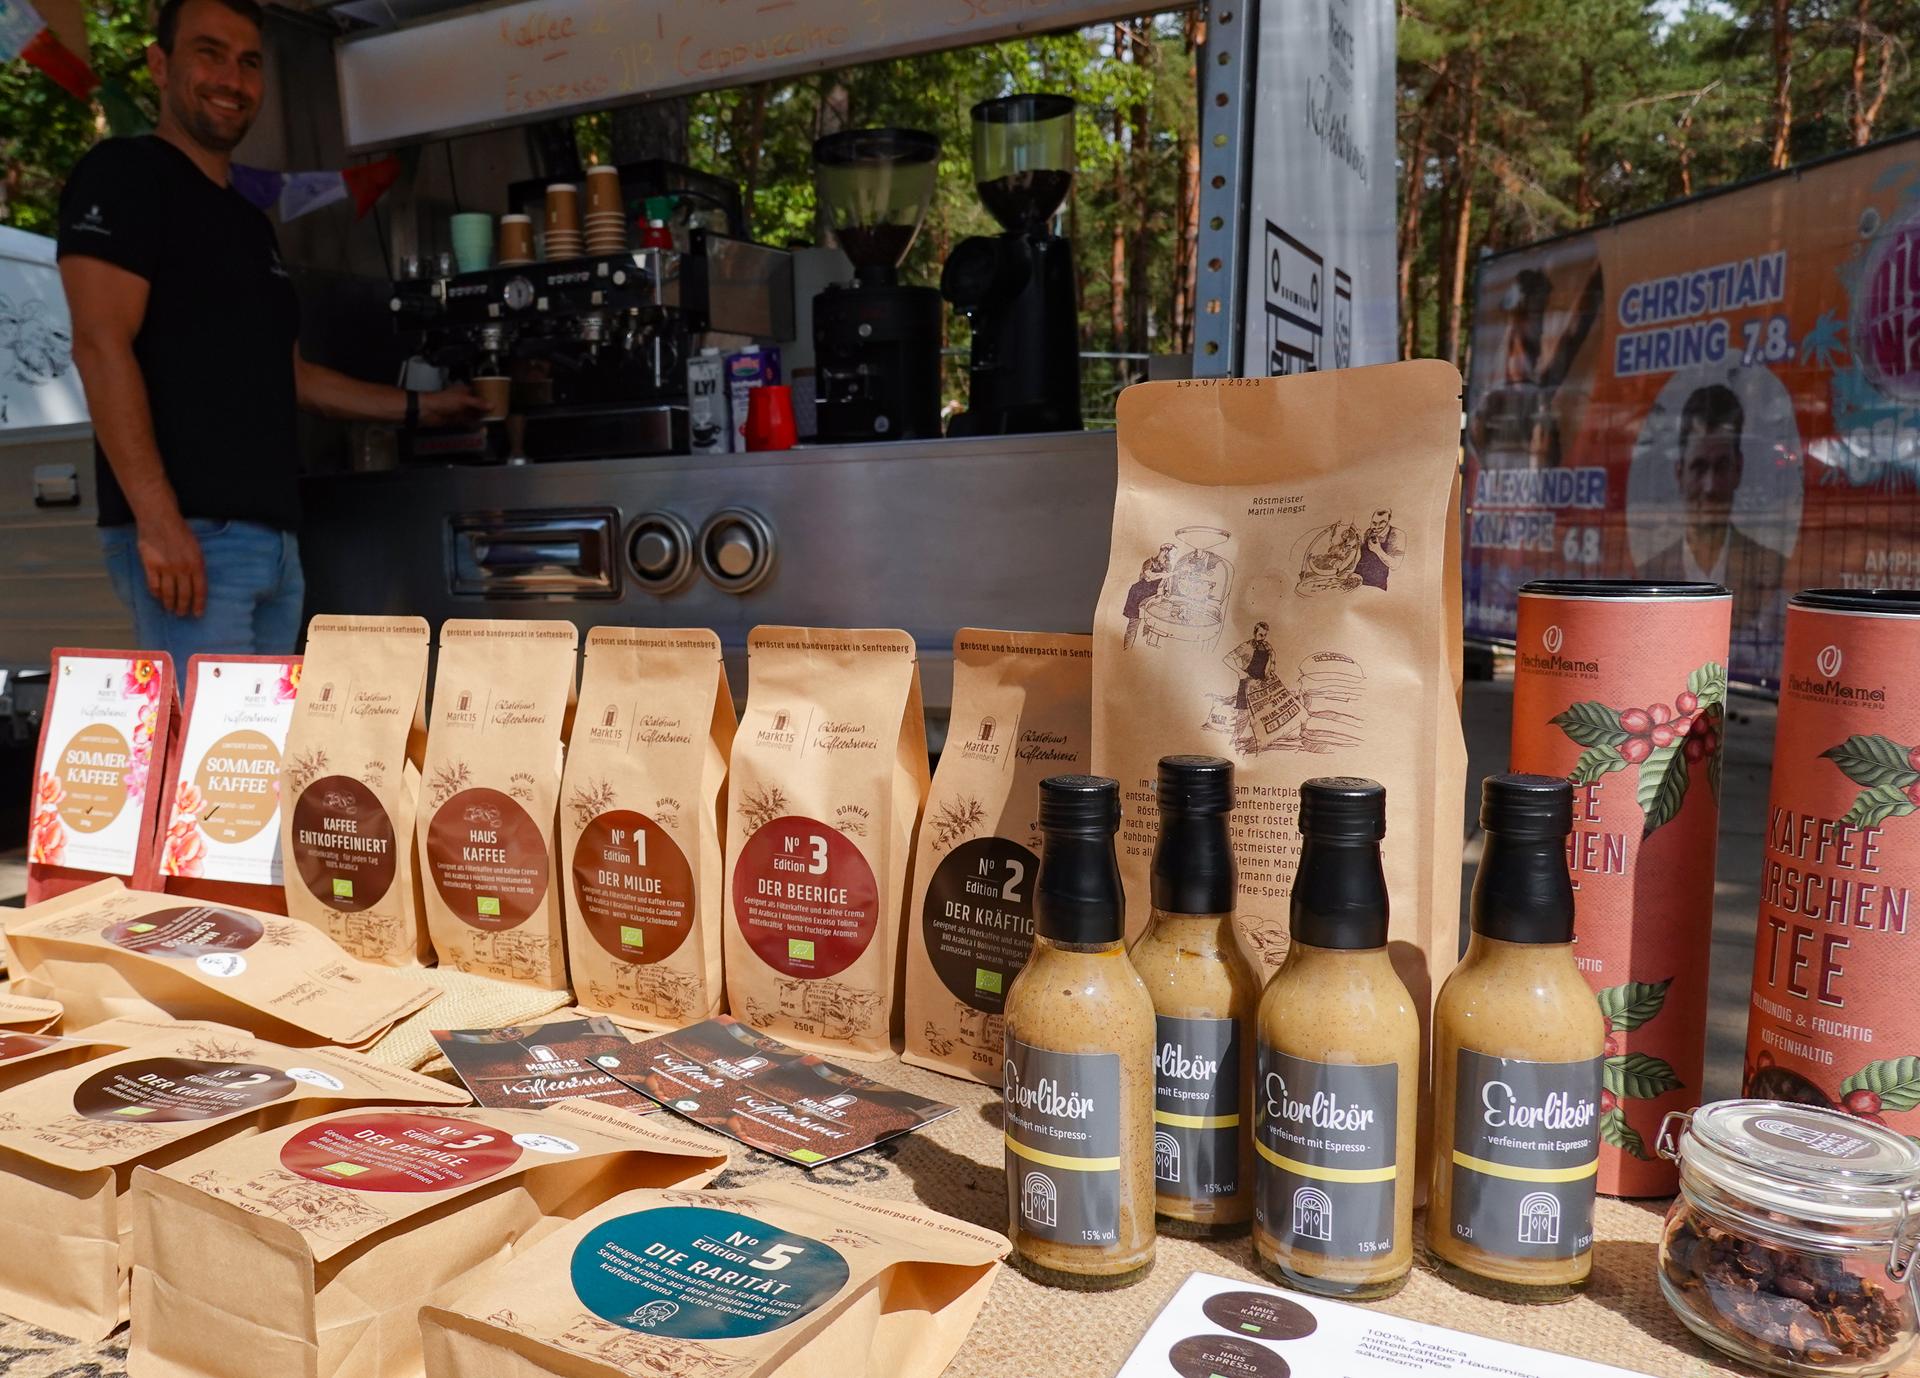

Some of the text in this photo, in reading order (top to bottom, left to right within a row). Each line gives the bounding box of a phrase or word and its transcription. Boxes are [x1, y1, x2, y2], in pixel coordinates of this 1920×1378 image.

[1621, 254, 1784, 325] CHRISTIAN
[1616, 317, 1794, 374] EHRING 7.8.
[1177, 379, 1261, 388] 19.07.2023
[1475, 468, 1605, 507] ALEXANDER
[1253, 495, 1304, 505] Röstmeister
[1248, 504, 1306, 517] Martin Hengst
[1471, 512, 1554, 547] KNAPPE
[393, 627, 425, 635] Senftenberg
[447, 629, 472, 637] geröstet
[486, 630, 527, 638] handverpackt
[536, 631, 573, 640] Senftenberg
[755, 640, 909, 654] geröstet und handverpackt in Senftenberg
[960, 642, 989, 651] geröstet
[992, 643, 1004, 652] und
[1007, 646, 1057, 656] handverpackt
[309, 703, 327, 712] Markt
[446, 712, 477, 722] Markt 15
[590, 727, 612, 738] Markt
[757, 730, 795, 743] Markt 15
[963, 741, 999, 754] Markt 15
[66, 749, 126, 768] SOMMER
[206, 757, 275, 775] SOMMER
[67, 768, 119, 786] KAFFEE
[207, 776, 268, 794] KAFFEE
[510, 772, 536, 785] BOHNEN
[1140, 779, 1149, 788] Im
[1235, 786, 1300, 798] am Marktplat
[656, 797, 680, 810] BOHNEN
[836, 804, 869, 818] BOHNEN
[324, 818, 357, 833] KAFFEE
[1126, 818, 1144, 829] nach
[300, 830, 387, 853] ENTKOFFEINIERT
[470, 830, 497, 844] HAUS
[1247, 828, 1291, 840] frischen,
[1770, 806, 1884, 873] KAFFEE
[463, 847, 506, 863] KAFFEE
[603, 849, 631, 864] Edition
[633, 829, 646, 867] 1
[809, 835, 828, 875] 3
[1127, 847, 1140, 856] aus
[773, 858, 805, 874] Edition
[599, 871, 662, 894] DER MILDE
[1002, 859, 1024, 902] 2
[1276, 872, 1291, 883] die
[758, 878, 848, 905] DER BEERIGE
[966, 881, 998, 898] Edition
[1761, 856, 1909, 934] IRSCHEN
[945, 901, 1034, 935] DER KRÄFTIG
[1768, 915, 1850, 1008] TEE
[793, 1021, 814, 1035] 250g
[1795, 1014, 1873, 1043] & FRUCHTIG
[1761, 1028, 1833, 1065] KOFFEINHALTIG
[526, 1059, 580, 1072] Markt 15
[712, 1058, 747, 1075] Markt
[138, 1073, 176, 1090] DER
[172, 1085, 252, 1102] KRÄFTIGE
[183, 1074, 225, 1088] Edition
[222, 1073, 272, 1089] 2
[1005, 1058, 1094, 1120] Eierlikör
[1158, 1086, 1210, 1101] mit Espresso
[1265, 1072, 1375, 1131] Eierlikör
[798, 1097, 847, 1118] Markt 15
[1481, 1080, 1595, 1129] Eierlikör
[402, 1129, 445, 1147] Edition
[1034, 1123, 1087, 1141] mit Espresso
[1269, 1125, 1366, 1153] verfeinert mit Espresso
[354, 1129, 394, 1148] DER
[396, 1143, 470, 1167] BEERIGE
[444, 1134, 496, 1149] 3
[1488, 1134, 1588, 1153] verfeinert mit Espresso
[1204, 1183, 1222, 1194] 15%
[938, 1224, 1004, 1250] Senftenberg
[1081, 1229, 1117, 1240] 15% vol.
[691, 1238, 747, 1265] Edition
[1358, 1239, 1391, 1252] 15% vol.
[748, 1243, 805, 1271] 5
[605, 1241, 802, 1310] Geeignet als Filterkaffee und Kaffee Crema
[644, 1242, 792, 1296] DIE RARITÄT
[597, 1248, 792, 1318] Seltene Arabica aus dem Himalaya Nepal
[599, 1262, 766, 1321] kräftiges Aroma leichte Tabaknote
[1240, 1308, 1279, 1323] KAFFEE
[1250, 1305, 1275, 1315] HAUS
[1361, 1336, 1456, 1363] mittelkräftige
[1366, 1328, 1468, 1358] 100% Arabica
[1201, 1353, 1258, 1372] ESPRESSO
[1220, 1351, 1246, 1362] HAUS
[1355, 1349, 1423, 1370] säurearm
[1358, 1342, 1452, 1370] Alltagskaffee
